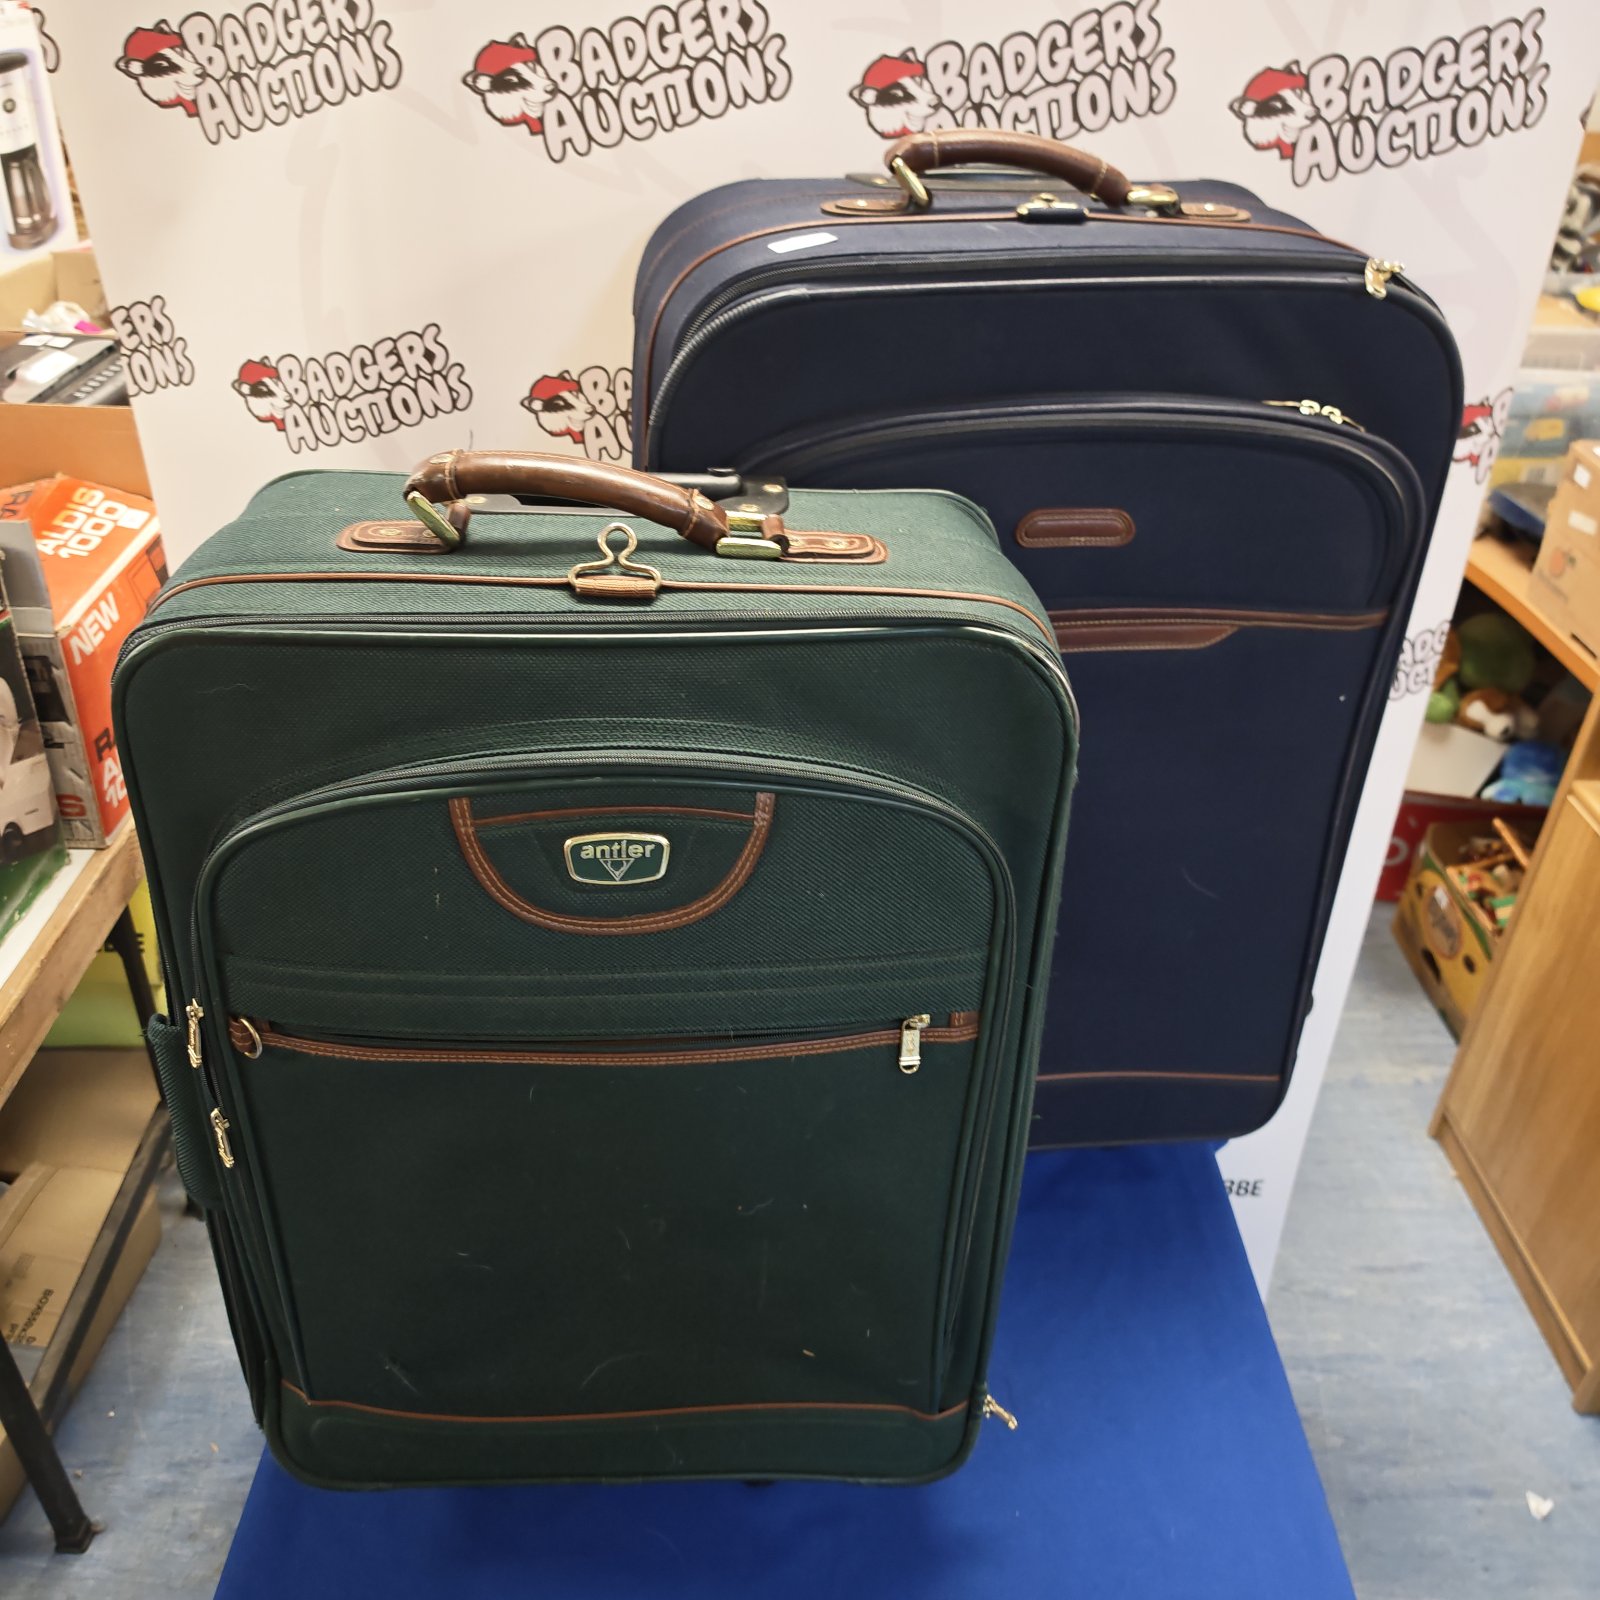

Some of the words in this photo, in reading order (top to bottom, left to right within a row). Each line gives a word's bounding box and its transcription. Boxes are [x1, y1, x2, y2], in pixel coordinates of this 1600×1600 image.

[196, 19, 402, 145] AUCTIONS
[543, 33, 792, 163] AUCTIONS
[924, 0, 1162, 112] BADGERS
[1307, 7, 1545, 124] BADGERS
[1291, 62, 1550, 188] AUCTIONS
[276, 322, 449, 406] BADGERS
[283, 362, 473, 455] AUCTIONS
[36, 487, 104, 556] ALDIS
[58, 500, 128, 559] 1000
[70, 592, 120, 666] NEW
[580, 839, 656, 860] antler
